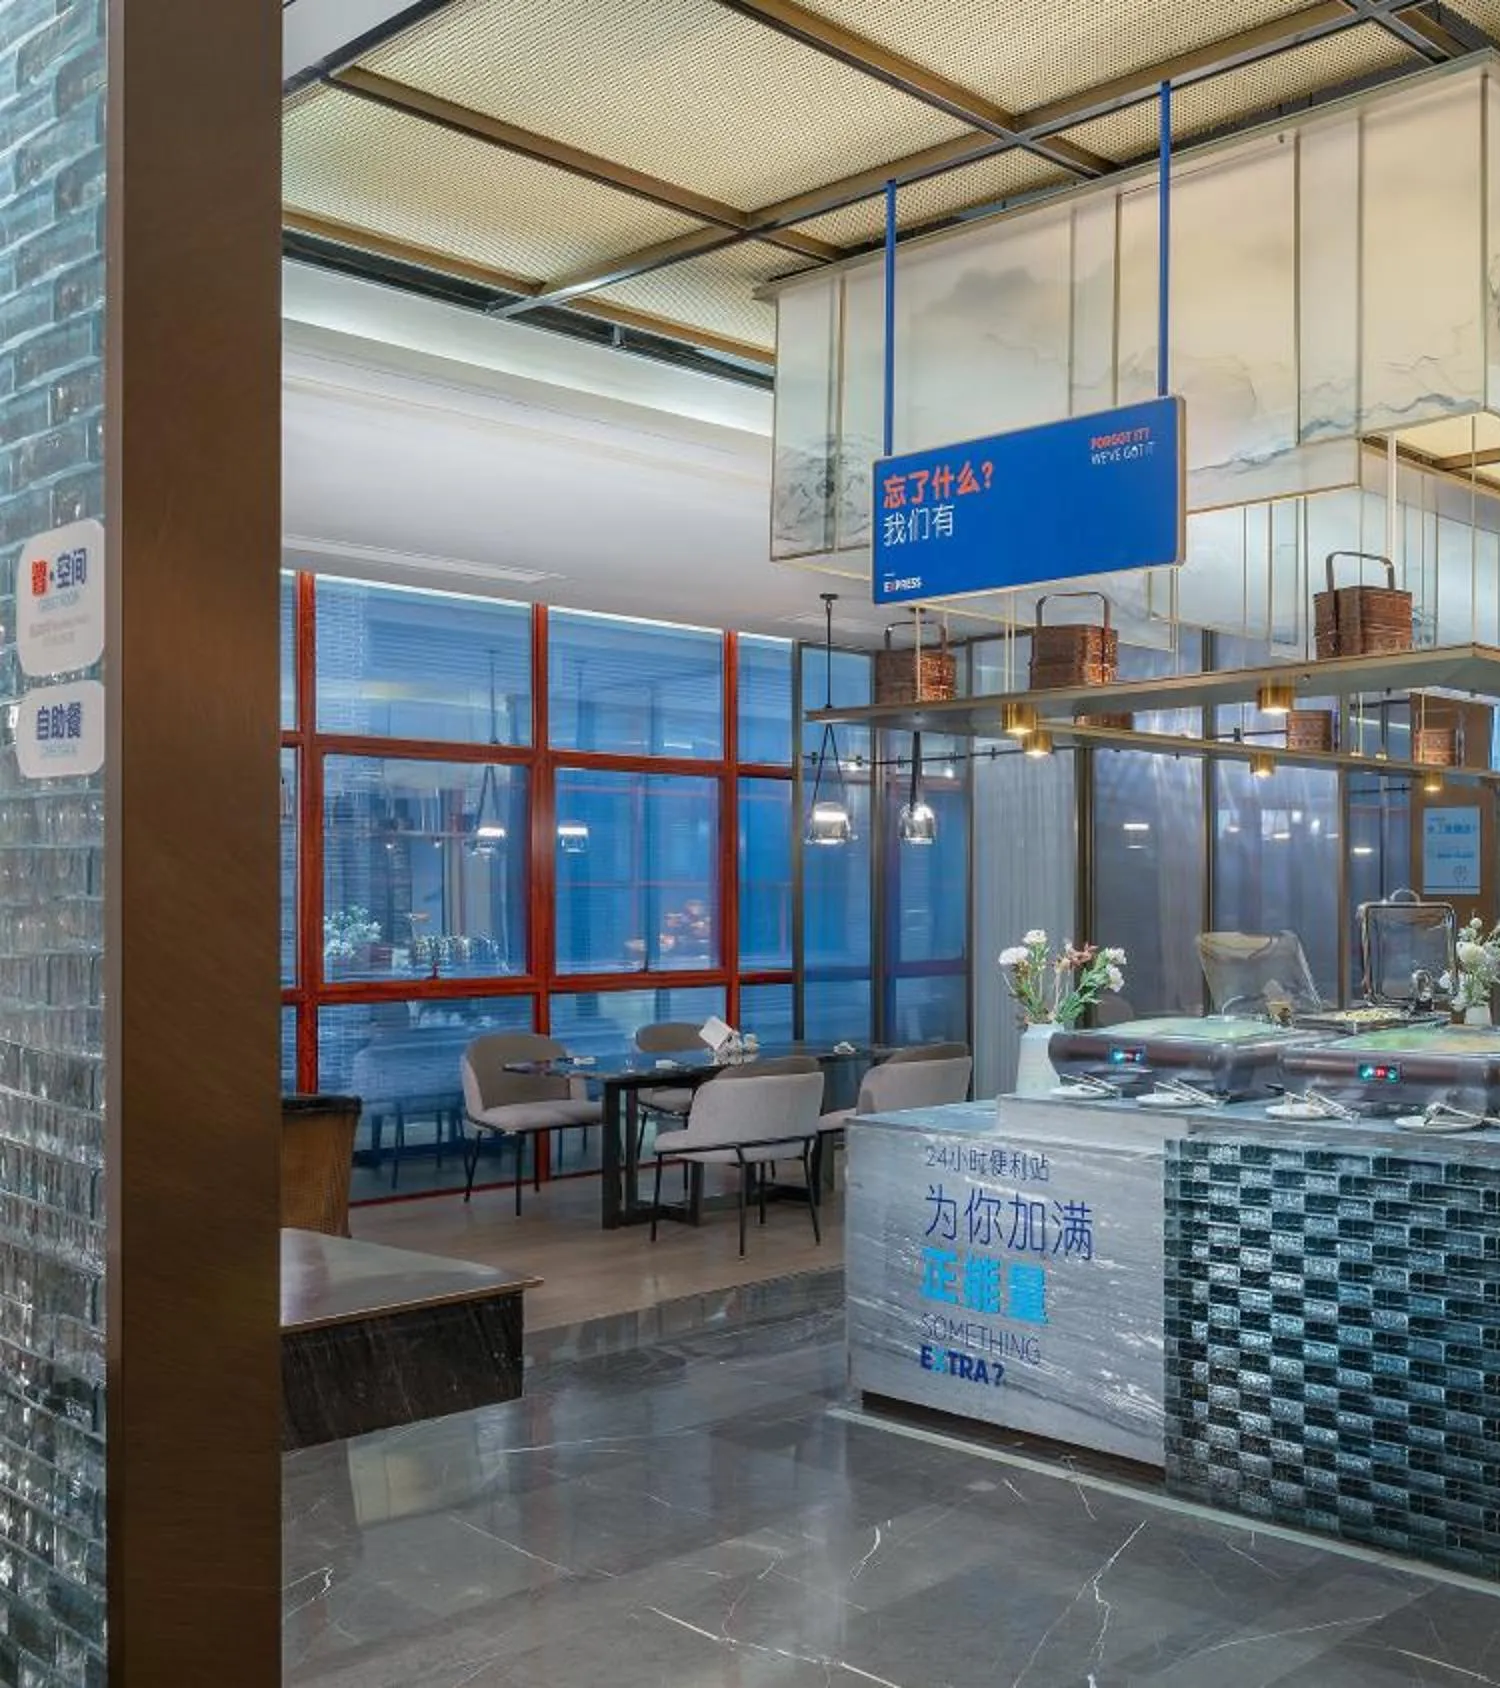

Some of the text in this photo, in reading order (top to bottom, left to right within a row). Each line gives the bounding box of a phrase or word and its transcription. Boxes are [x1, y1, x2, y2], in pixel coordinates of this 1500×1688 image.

[1123, 443, 1144, 459] GOT
[883, 503, 955, 547] 我们有
[883, 576, 922, 593] EXPRESS
[36, 702, 82, 741] 自助餐
[925, 1146, 1049, 1182] 24小时便利站
[925, 1183, 1093, 1261] 为你加满
[919, 1247, 1049, 1327] 正能量
[920, 1311, 1041, 1365] SOMETHING
